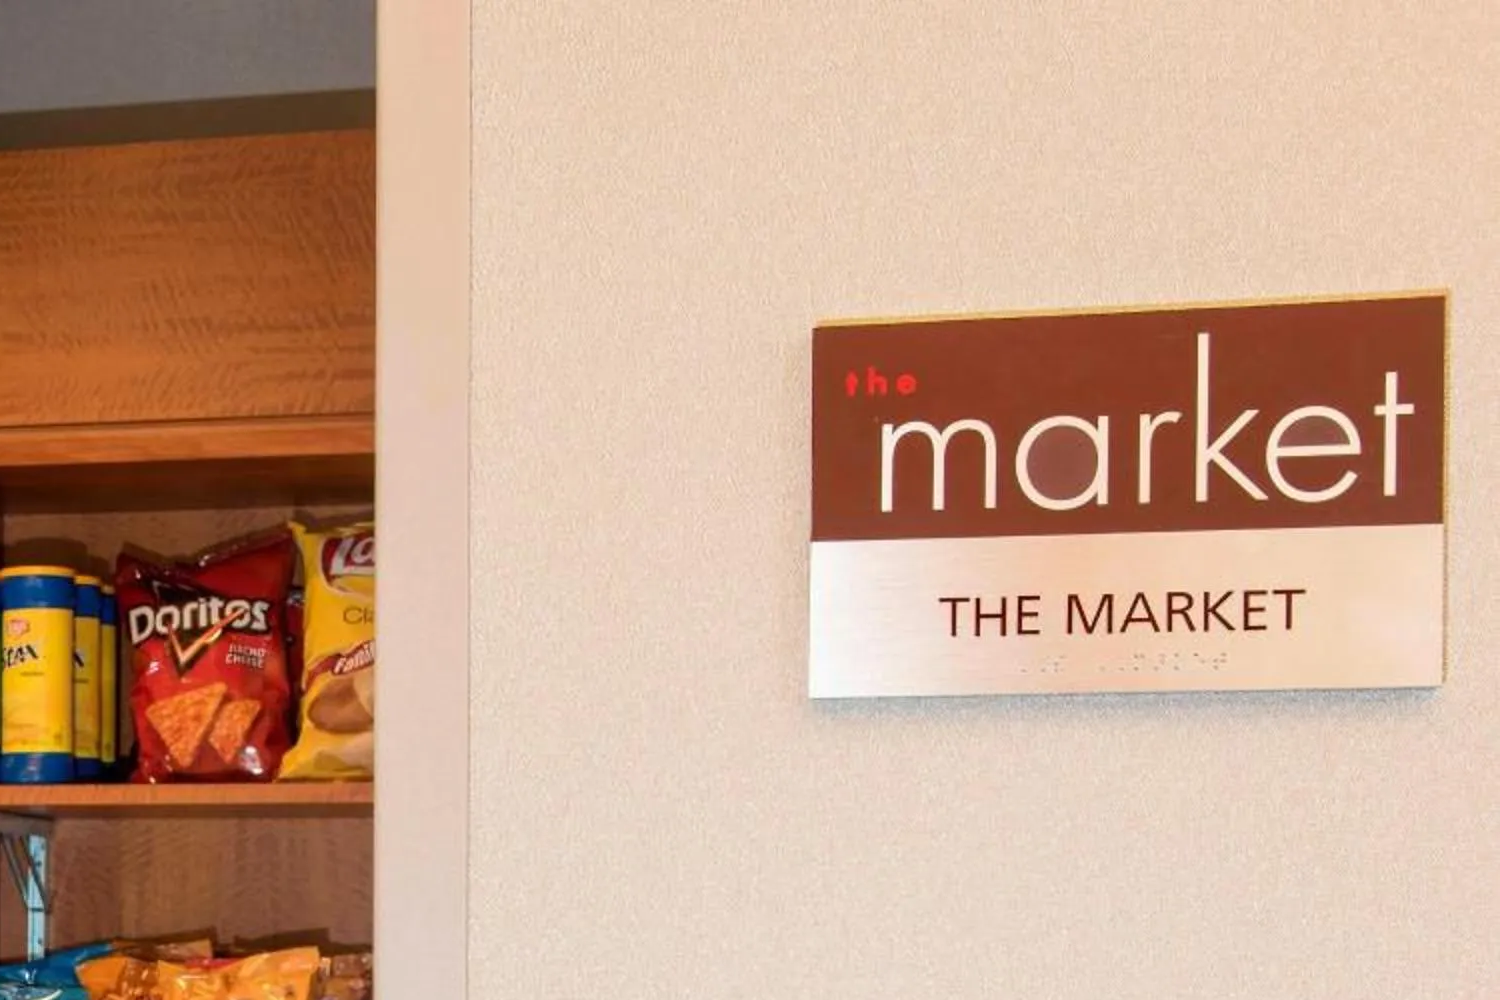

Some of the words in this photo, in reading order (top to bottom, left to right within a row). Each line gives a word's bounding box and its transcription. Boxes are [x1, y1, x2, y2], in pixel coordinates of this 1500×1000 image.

[844, 366, 918, 397] the
[880, 332, 1415, 513] market
[129, 596, 271, 645] Doritos
[938, 593, 1041, 637] THE
[1066, 588, 1307, 635] MARKET
